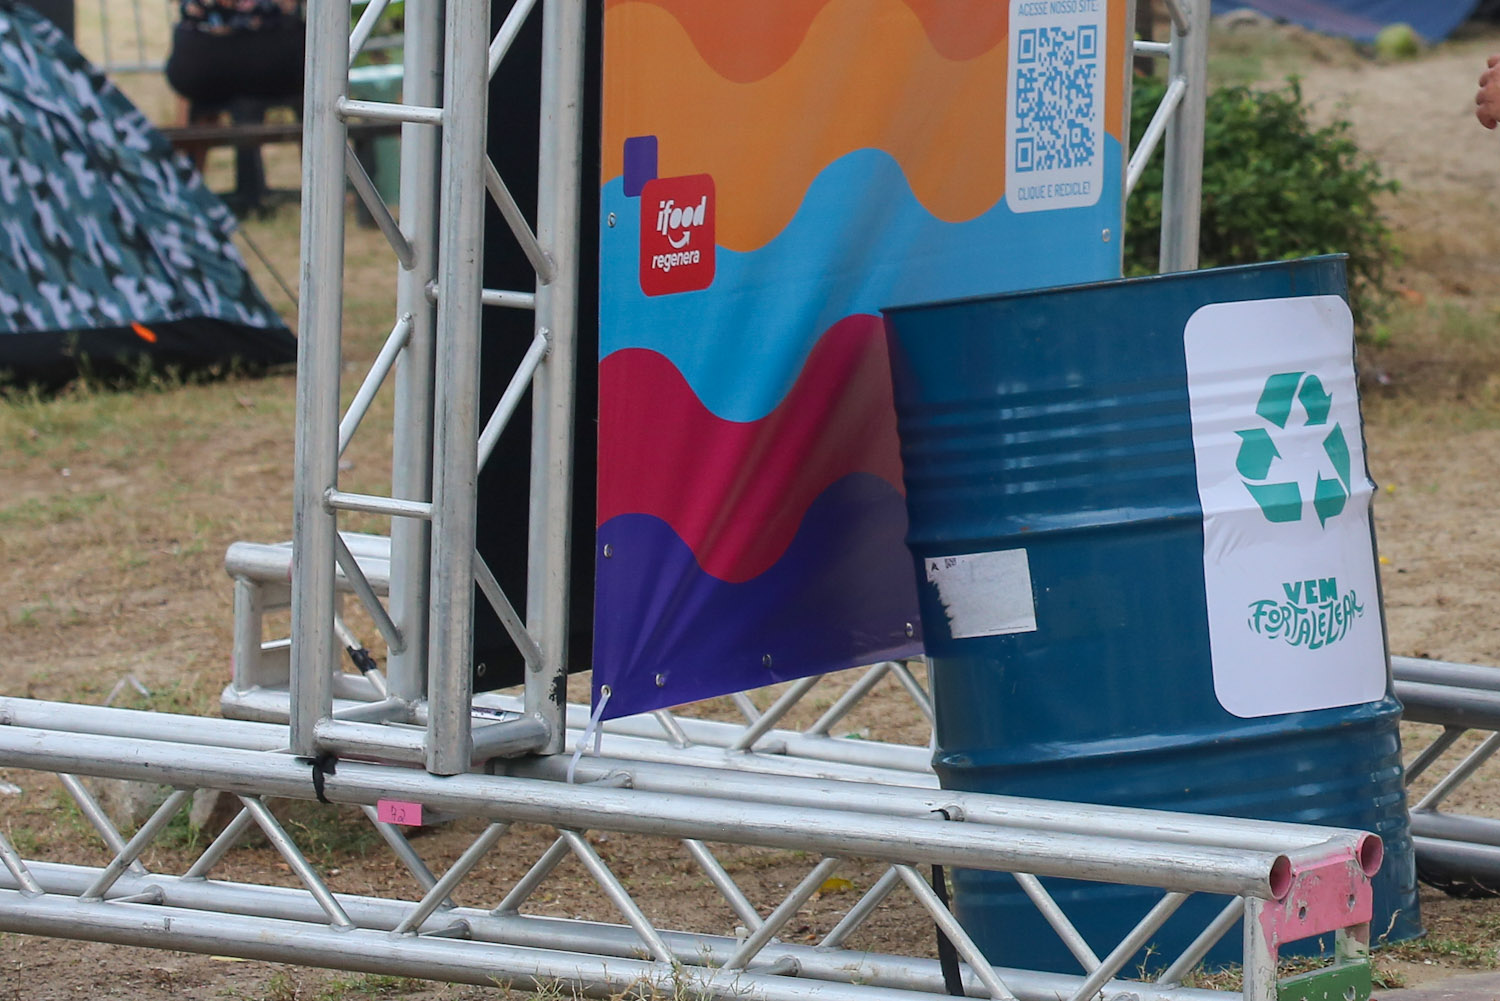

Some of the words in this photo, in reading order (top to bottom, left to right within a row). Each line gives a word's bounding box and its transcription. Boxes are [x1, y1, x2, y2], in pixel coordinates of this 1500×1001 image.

[1018, 1, 1048, 17] ACESSE
[1050, 0, 1077, 15] NOSSO
[1017, 184, 1046, 201] CLIQUE
[1047, 184, 1053, 198] E
[651, 250, 700, 272] regenera
[1282, 577, 1338, 605] VEM
[1247, 589, 1365, 650] FORTALEZEAR
